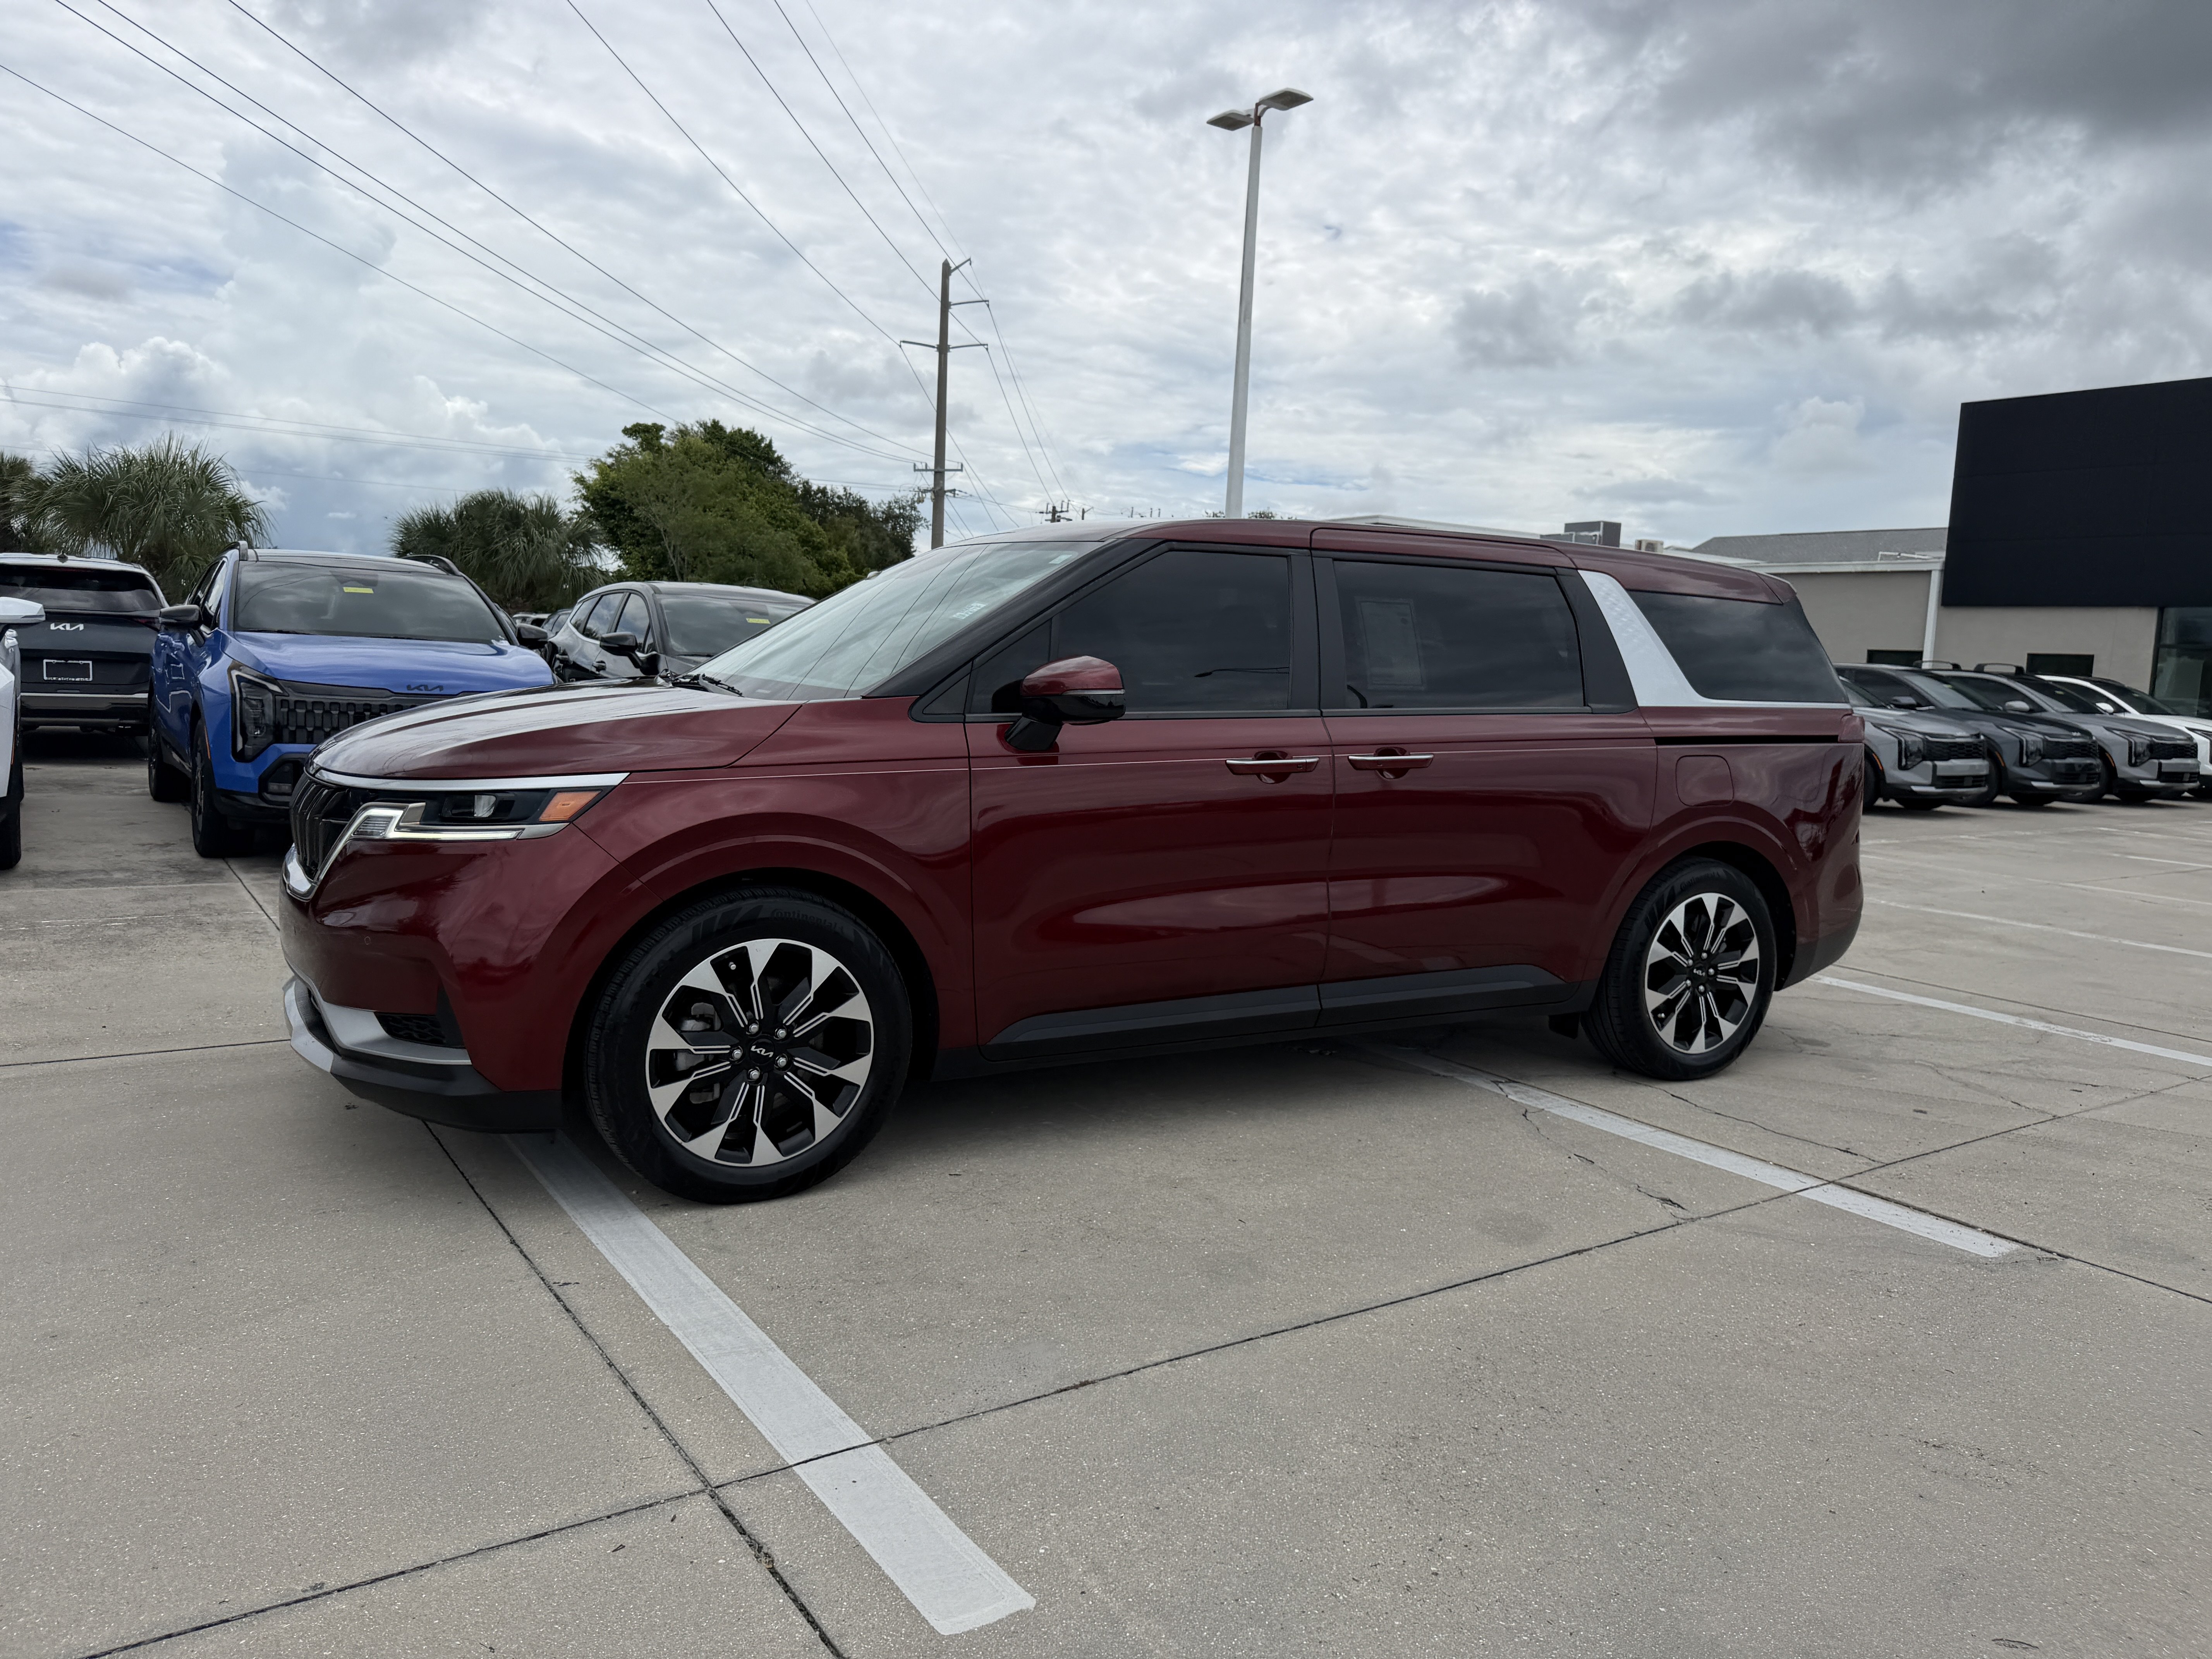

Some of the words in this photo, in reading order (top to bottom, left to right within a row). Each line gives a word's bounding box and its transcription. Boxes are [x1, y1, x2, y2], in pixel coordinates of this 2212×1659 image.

[50, 623, 84, 631] KIA
[771, 908, 837, 931] Continental
[750, 1045, 774, 1058] KIA
